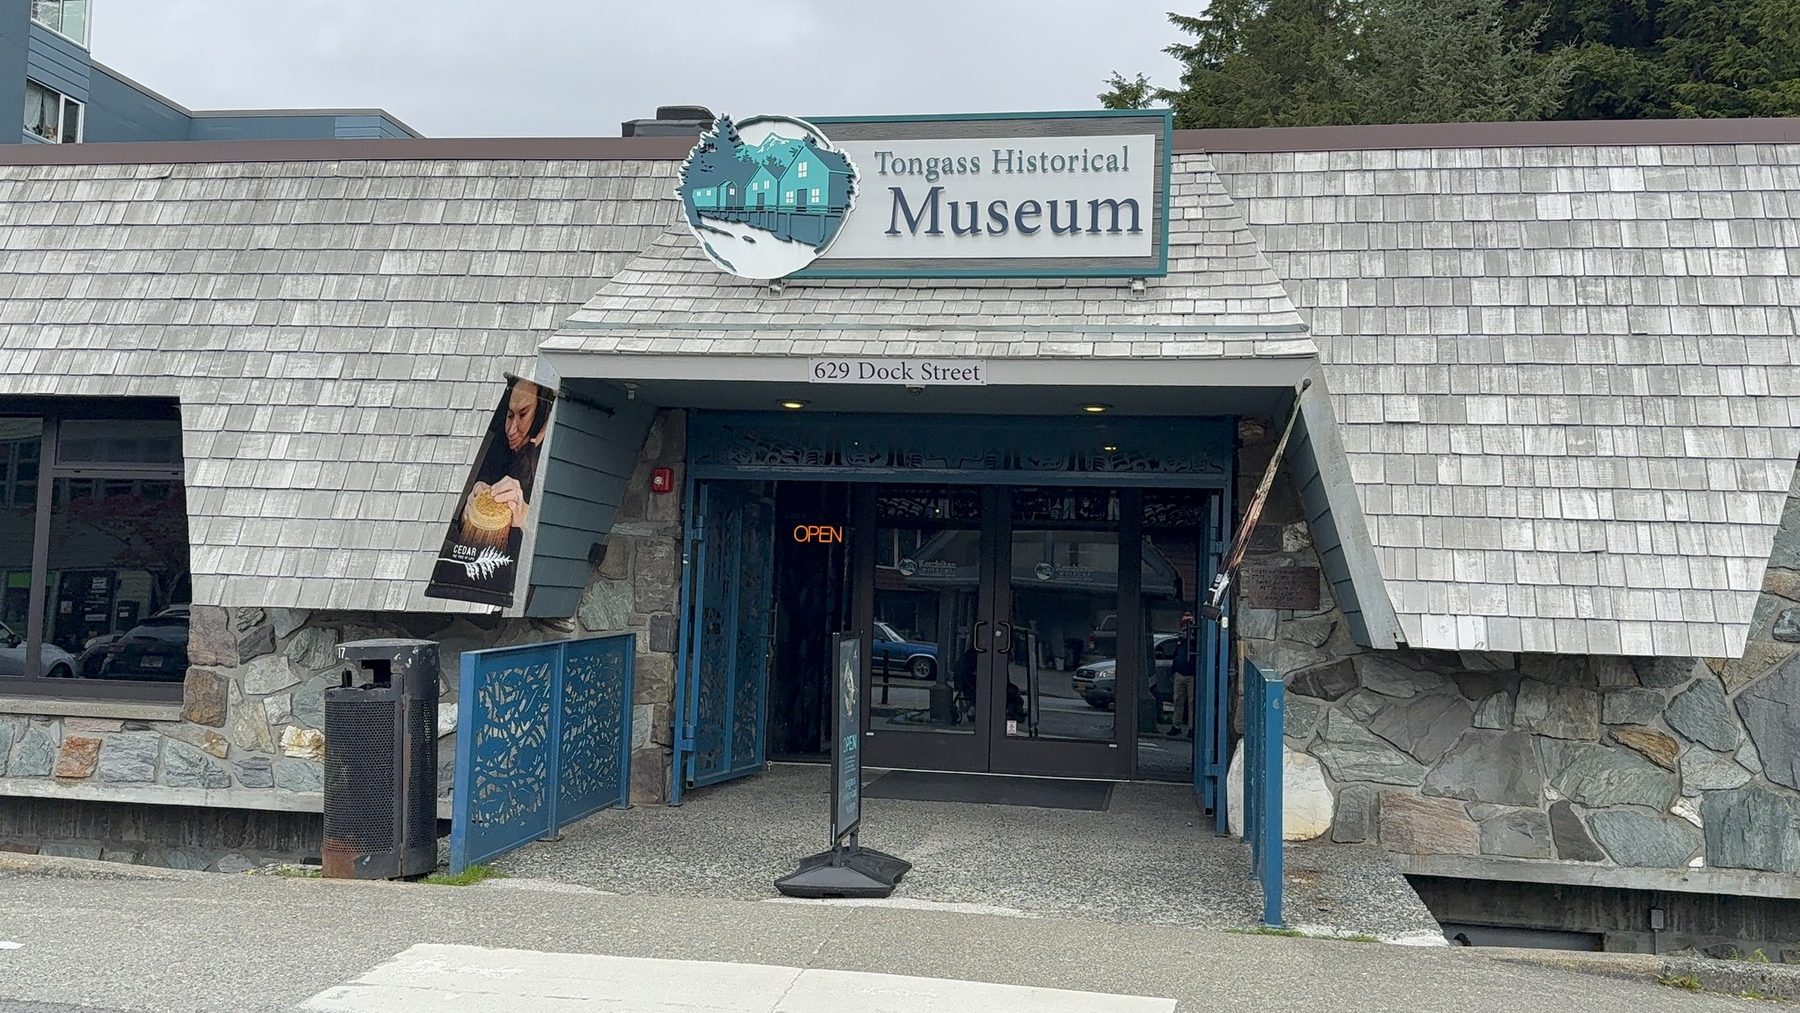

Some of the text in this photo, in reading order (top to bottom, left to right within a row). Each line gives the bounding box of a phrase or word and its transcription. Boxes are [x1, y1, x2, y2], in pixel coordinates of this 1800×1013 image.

[874, 145, 1130, 183] Tongass Historical
[884, 186, 1144, 236] Museum
[814, 361, 981, 381] 629 Dock Street
[793, 525, 843, 543] OPEN
[453, 544, 477, 557] CEDAR
[338, 646, 346, 659] 17
